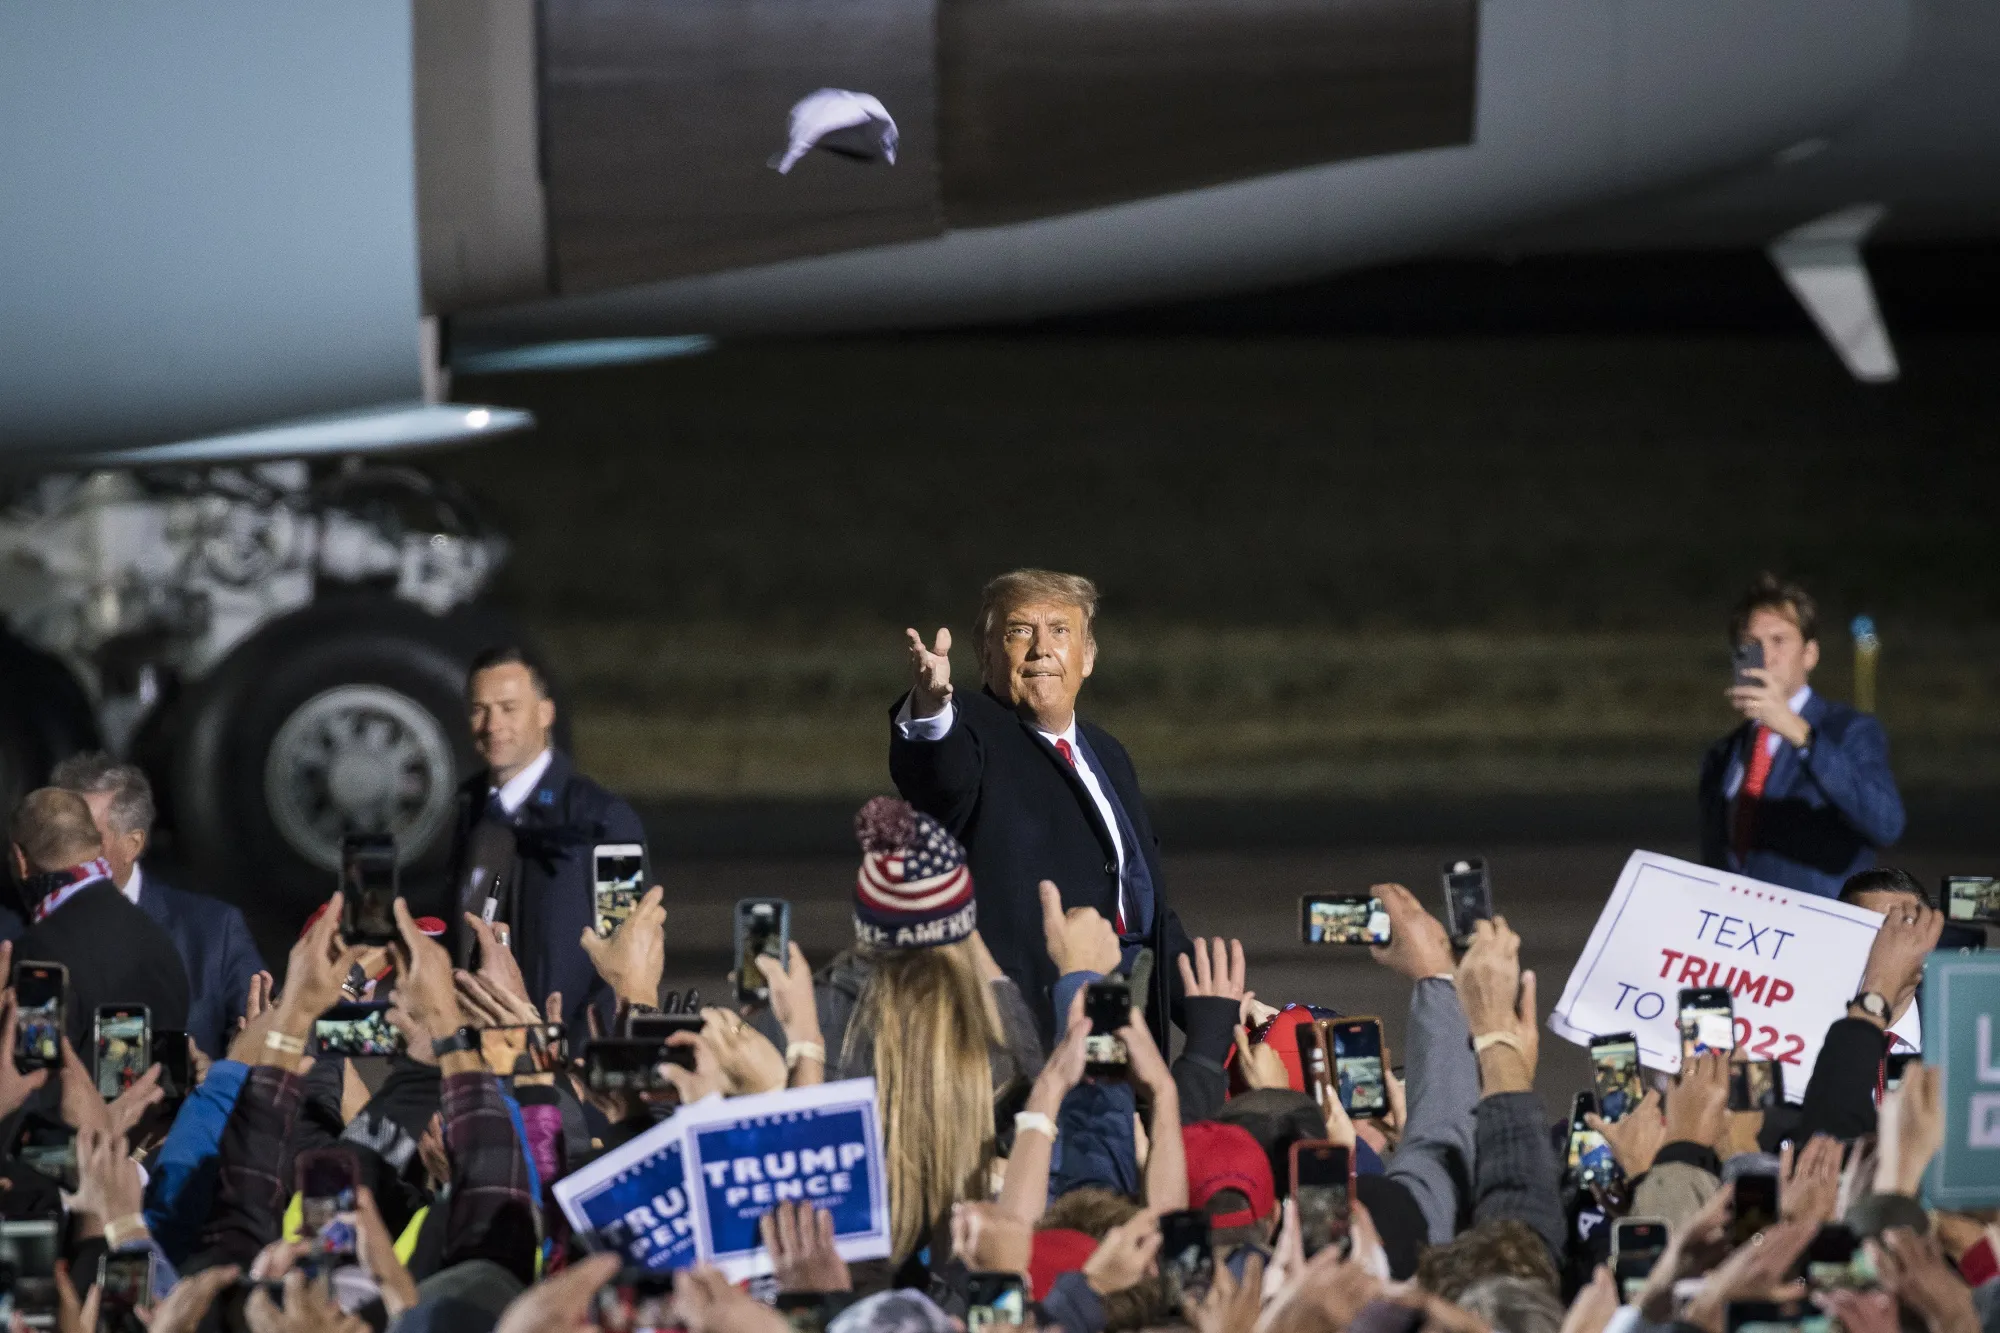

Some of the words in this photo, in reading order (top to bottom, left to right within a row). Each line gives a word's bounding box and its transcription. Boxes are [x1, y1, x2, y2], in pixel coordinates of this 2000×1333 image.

[1697, 909, 1795, 960] TEXT
[1615, 981, 1665, 1021] TO
[1659, 948, 1795, 1008] TRUMP
[703, 1142, 865, 1188] TRUMP
[726, 1172, 852, 1207] PENCE
[601, 1184, 688, 1246] TRU
[629, 1217, 691, 1259] PEN
